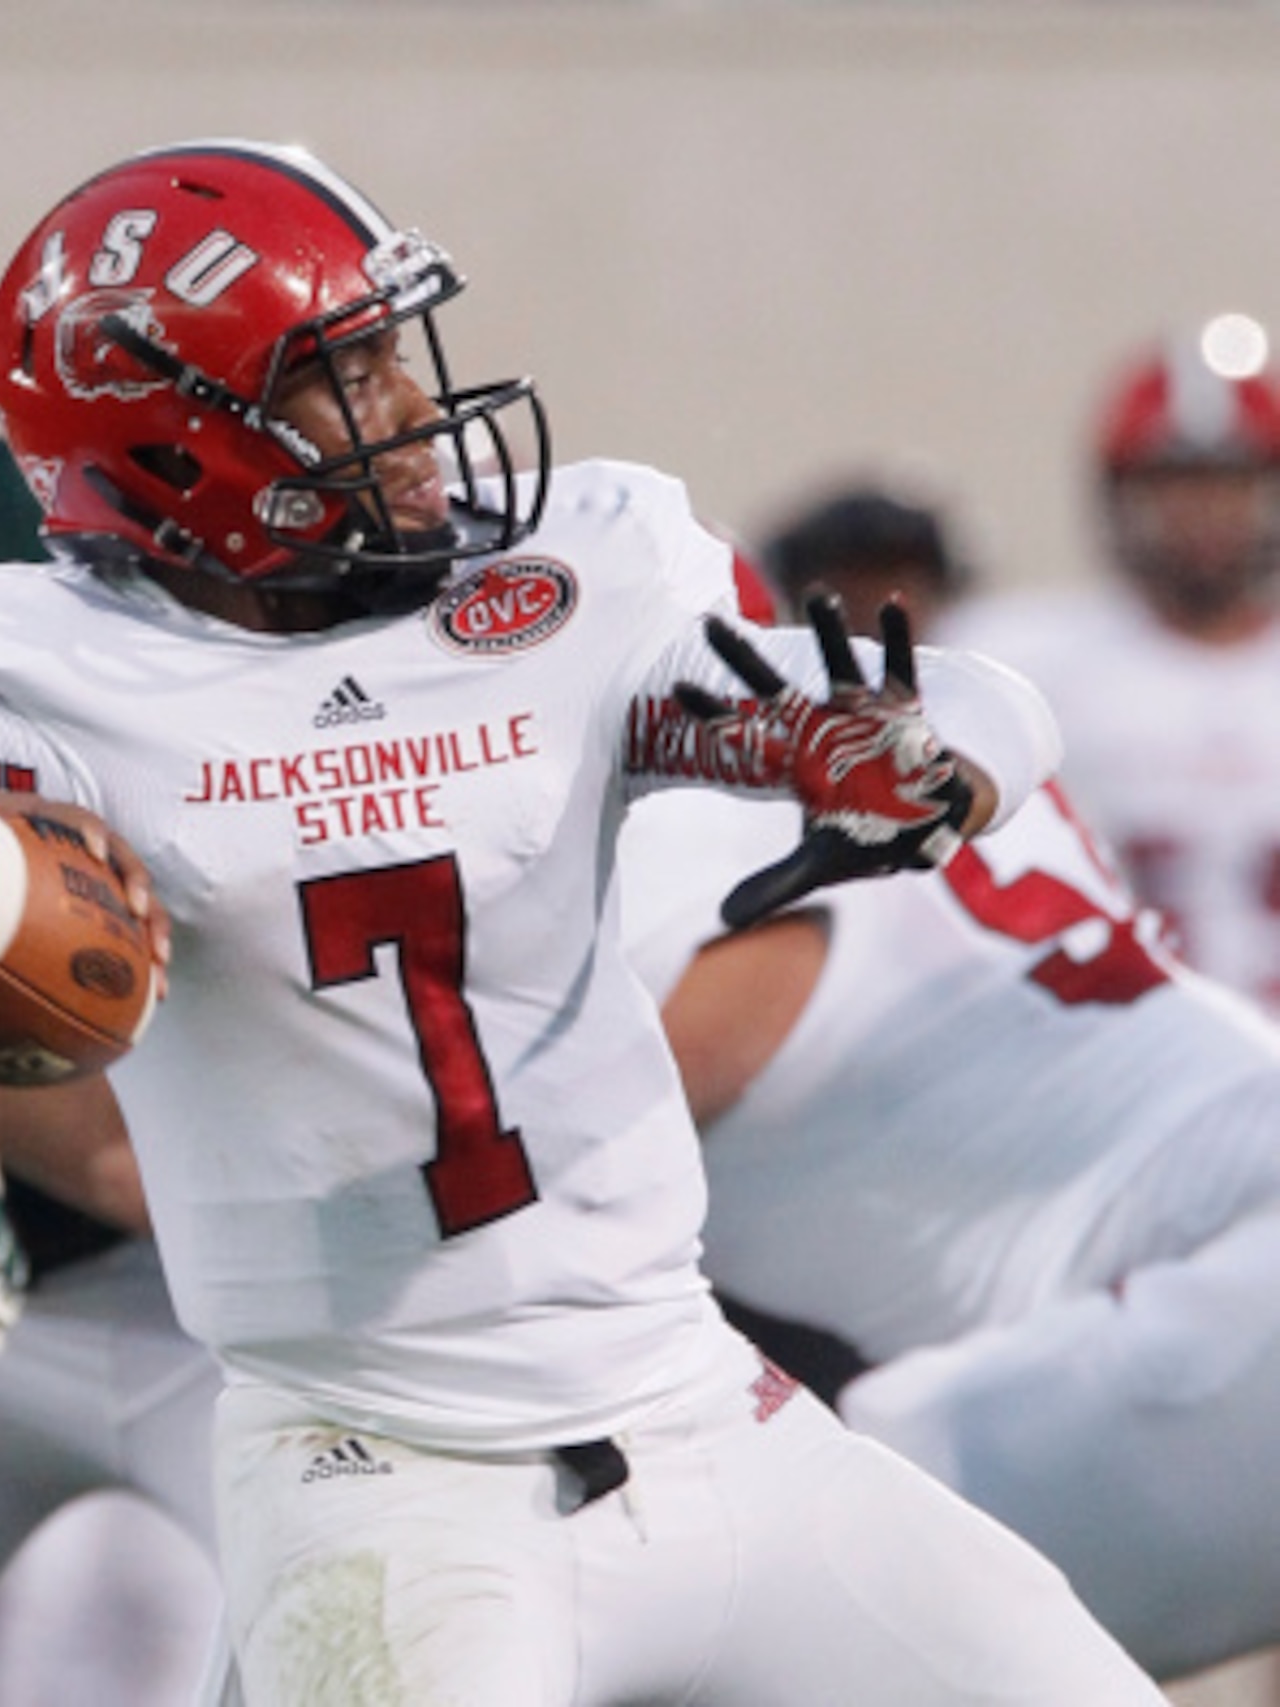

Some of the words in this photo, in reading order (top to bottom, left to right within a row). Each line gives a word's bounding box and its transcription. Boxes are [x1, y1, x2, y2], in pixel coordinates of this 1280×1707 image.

[20, 209, 259, 322] JSU
[467, 581, 542, 632] OVC
[184, 713, 538, 803] JACKSONVILLE
[295, 785, 445, 845] STATE
[295, 850, 542, 1241] 7
